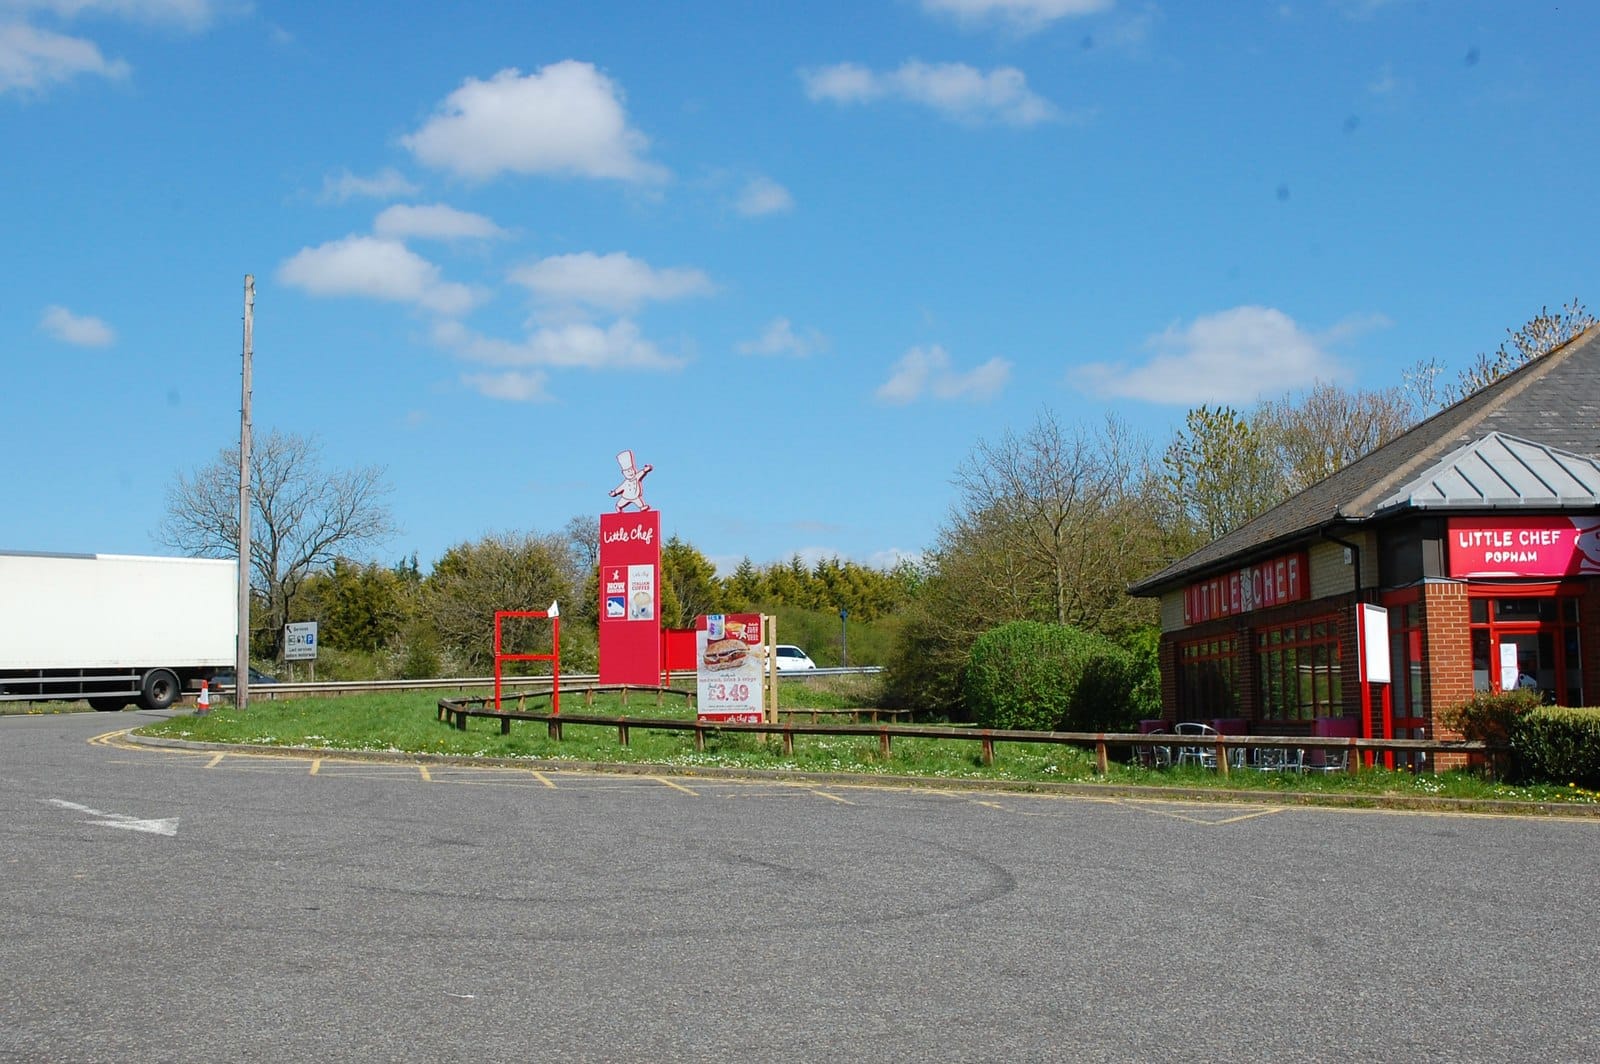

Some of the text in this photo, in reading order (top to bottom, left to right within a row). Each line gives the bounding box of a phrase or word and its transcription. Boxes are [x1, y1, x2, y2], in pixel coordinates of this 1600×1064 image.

[604, 524, 653, 545] Little Chef
[1459, 530, 1561, 548] LITTLE CHEF
[1484, 551, 1538, 562] POPHAM
[1184, 558, 1297, 621] LITTLE CHEF
